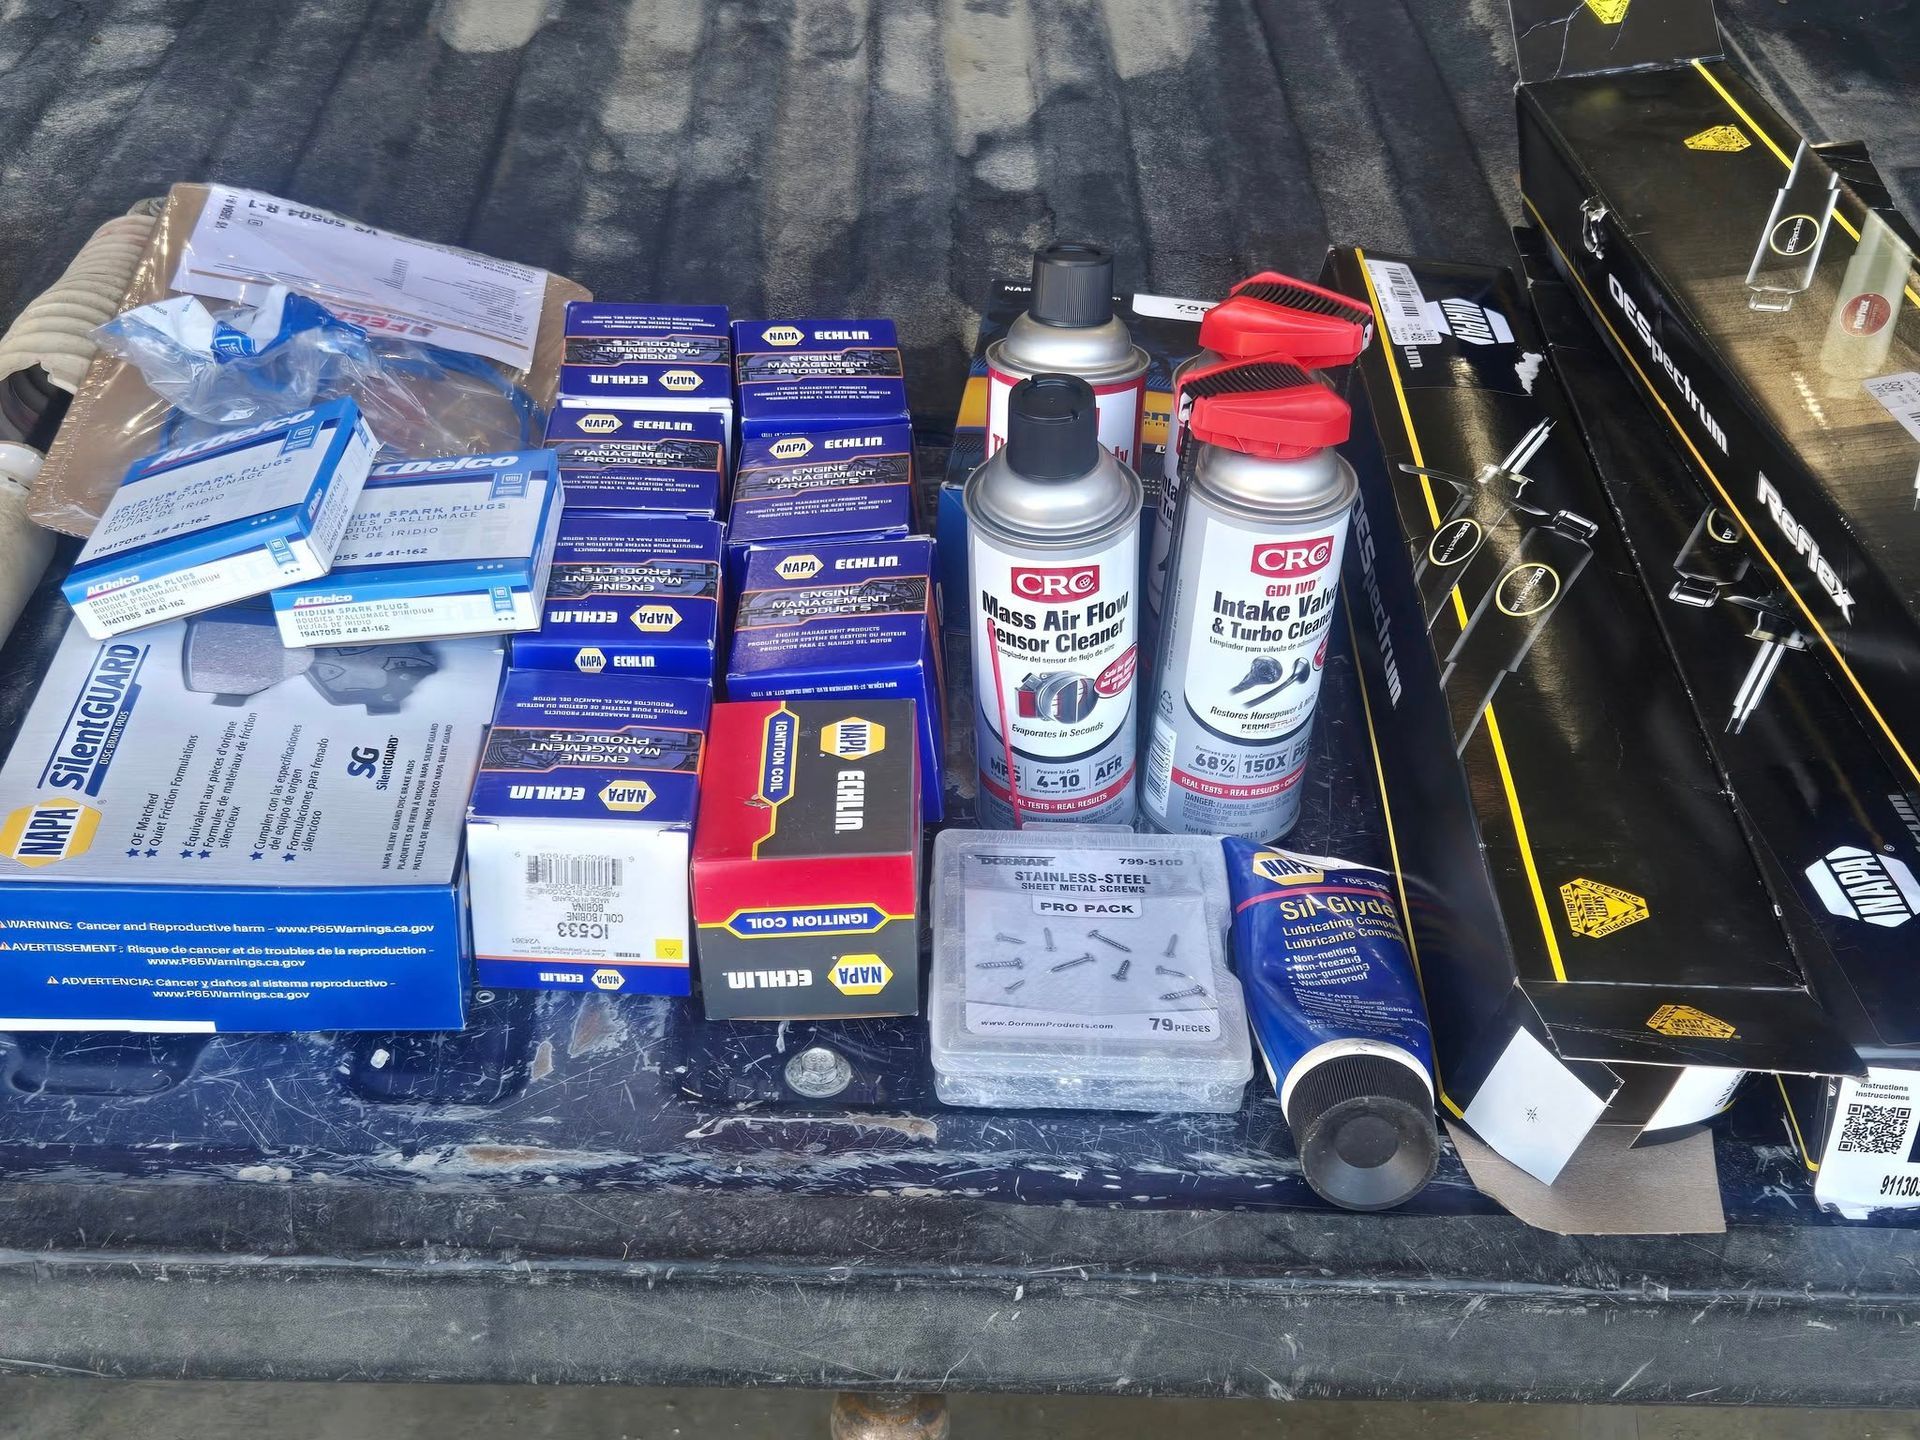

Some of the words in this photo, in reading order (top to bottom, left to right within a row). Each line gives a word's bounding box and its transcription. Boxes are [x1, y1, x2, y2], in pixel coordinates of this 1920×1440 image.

[769, 331, 799, 341] NAPA
[813, 330, 870, 340] ECHLIN
[1606, 273, 1730, 457] OESpectrum
[589, 374, 649, 385] ECHLIN
[666, 376, 697, 386] NAPA
[584, 419, 616, 428] NAPA
[633, 420, 694, 431] ECHLIN
[776, 443, 807, 454] NAPA
[824, 436, 884, 449] ECHLIN
[767, 469, 876, 485] MANAGEMENT
[792, 465, 849, 475] ENGINE
[114, 490, 177, 515] IRIDIUM
[184, 472, 235, 492] SPARK
[241, 457, 292, 474] PLUGS
[777, 477, 860, 490] PRODUCTS
[383, 511, 479, 525] D'ALLUMAGE
[389, 507, 444, 518] SPARK
[451, 502, 508, 513] PLUGS
[391, 527, 439, 537] IRIDIO
[386, 548, 429, 556] 41-162
[1257, 541, 1331, 572] CRC
[1757, 469, 1857, 626] Reflex
[783, 560, 816, 573] NAPA
[834, 556, 900, 570] ECHLIN
[87, 575, 141, 596] ACDelco
[1016, 570, 1096, 596] CRC
[1265, 584, 1292, 597] GDI
[1294, 579, 1317, 596] IVD
[89, 591, 128, 608] IRIDIUM
[130, 582, 163, 596] SPARK
[771, 594, 891, 609] MANAGEMENT
[800, 589, 861, 599] ENGINE
[102, 612, 143, 627] 19417055
[157, 599, 187, 612] 41-162
[294, 608, 335, 617] IRIDIUM
[338, 605, 373, 614] SPARK
[376, 602, 410, 611] PLUGS
[782, 603, 873, 617] PRODUCTS
[982, 590, 1037, 630] Mass
[1043, 610, 1081, 632] Air
[1087, 590, 1130, 627] Flow
[1213, 590, 1292, 622] Intake
[550, 611, 619, 623] ECHLIN
[639, 612, 673, 624] NAPA
[299, 627, 342, 638] 19417055
[361, 624, 391, 633] 41-162
[1055, 616, 1126, 653] Cleaner
[1211, 617, 1225, 636] &
[1230, 620, 1284, 642] Turbo
[580, 655, 602, 667] NAPA
[613, 655, 656, 668] ECHLIN
[49, 643, 141, 792] SilentGUARD
[1210, 704, 1249, 721] Restores
[1250, 705, 1298, 721] Horsepower
[838, 723, 868, 755] NAPA
[1011, 723, 1058, 739] Evaporates
[1069, 721, 1105, 738] Seconds
[98, 747, 112, 766] DISC
[105, 726, 123, 751] BRAKE
[550, 734, 650, 745] PRODUCTS
[771, 720, 788, 767] IGNITION
[527, 742, 661, 756] MANAGEMENT
[346, 745, 381, 780] SG
[376, 735, 399, 792] SilentGUARD
[561, 754, 629, 763] ENGINE
[1195, 752, 1237, 774] 68%
[1244, 753, 1288, 775] 150X
[1094, 755, 1123, 782] AFR
[769, 767, 784, 793] COIL
[1036, 774, 1081, 789] 4-10
[1181, 775, 1199, 790] REAL
[1199, 783, 1223, 796] TESTS
[1229, 788, 1250, 797] REAL
[1250, 783, 1281, 797] RESULTS
[149, 818, 169, 848] Quiet
[162, 788, 179, 821] Friction
[171, 734, 200, 788] Formulations
[509, 785, 586, 801] ECHLIN
[607, 788, 647, 803] NAPA
[834, 769, 866, 832] ECHLIN
[1027, 800, 1051, 810] TESTS
[1056, 803, 1077, 811] REAL
[1078, 792, 1108, 808] RESULTS
[136, 792, 160, 832] Matched
[274, 805, 293, 836] equipo
[285, 789, 316, 851] Formulaciones
[17, 807, 80, 856] NAPA
[183, 799, 210, 849] Équivalent
[202, 804, 224, 849] Formules
[219, 805, 242, 850] silencieux
[253, 812, 273, 851] Cumplen
[302, 809, 323, 853] silencioso
[130, 831, 143, 847] OE
[981, 857, 1052, 867] DORMAN
[1014, 870, 1152, 885] STAINLESS-STEEL
[1829, 856, 1909, 917] NAPA
[1021, 882, 1057, 891] SHEET
[1059, 883, 1097, 893] METAL
[1099, 884, 1146, 894] SCREWS
[1580, 879, 1640, 904] STEERING
[571, 902, 604, 913] BOBINA
[1040, 901, 1079, 913] PRO
[1083, 903, 1135, 914] PACK
[1279, 895, 1397, 922] Sil-Glyde
[1561, 887, 1583, 930] STABILITY
[566, 911, 598, 923] BOBINE
[606, 913, 625, 924] COIL
[746, 916, 788, 930] COIL
[792, 912, 869, 928] IGNITION
[1594, 911, 1646, 936] STOPPING
[8, 920, 73, 931] WARNING:
[77, 921, 121, 931] Cancer
[123, 922, 147, 931] and
[149, 922, 231, 933] Reproductive
[233, 924, 266, 933] harm
[275, 924, 435, 935] www.P65Warnings.ca.gov
[557, 921, 609, 940] IC533
[1282, 916, 1355, 938] Lubricating
[13, 942, 118, 953] AVERTISSEMENT
[127, 945, 169, 956] Risque
[170, 945, 187, 954] de
[188, 946, 231, 955] cancer
[232, 947, 245, 955] et
[247, 946, 263, 955] de
[264, 946, 315, 956] troubles
[316, 946, 333, 956] de
[334, 946, 346, 956] la
[347, 946, 427, 957] reproduction
[1293, 945, 1358, 964] Non-melting
[146, 957, 306, 969] www.P65Warnings.ca.gov
[1294, 954, 1363, 973] Non-freezing
[1296, 962, 1371, 982] Non-gumming
[61, 976, 154, 986] ADVERTENCIA:
[155, 977, 199, 987] Cáncer
[201, 979, 210, 989] y
[210, 978, 248, 988] daños
[249, 979, 261, 988] al
[262, 979, 309, 988] sistema
[310, 979, 389, 989] reproductivo
[538, 972, 585, 984] ECHLIN
[596, 973, 621, 985] NAPA
[727, 967, 813, 990] ECHLIN
[837, 965, 884, 985] NAPA
[1298, 971, 1370, 988] Weatherproof
[152, 989, 310, 1001] www.P65Warnings.ca.gov
[980, 1018, 1115, 1031] www.DormanProducts.com
[1149, 1017, 1174, 1032] 79
[1174, 1023, 1212, 1034] PIECES
[1855, 1091, 1911, 1102] Instrucciones
